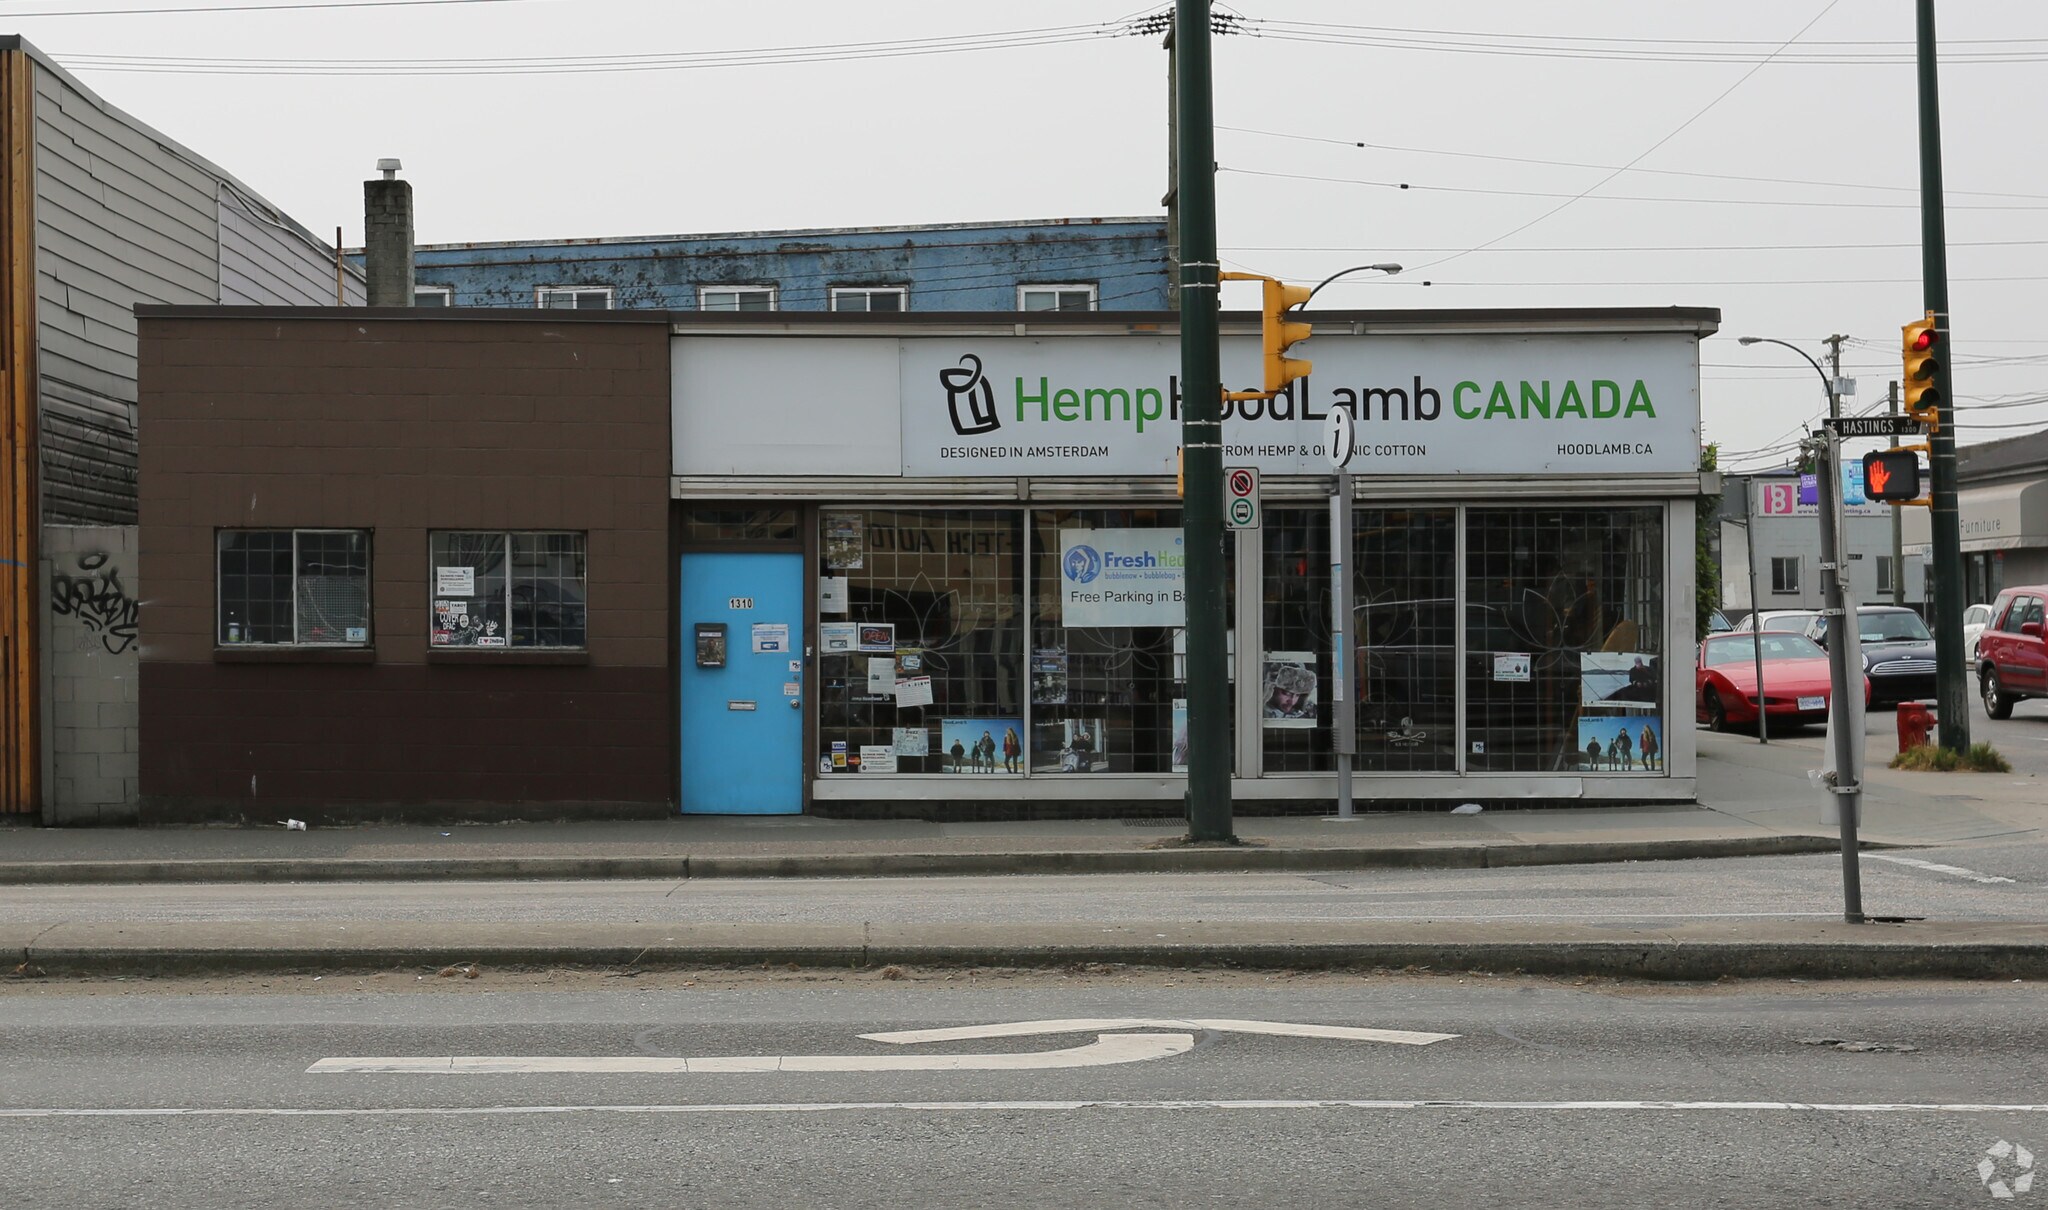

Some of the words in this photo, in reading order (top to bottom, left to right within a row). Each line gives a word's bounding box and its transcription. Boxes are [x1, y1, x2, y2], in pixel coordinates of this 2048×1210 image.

[1453, 379, 1656, 420] CANADA
[1843, 420, 1894, 434] HASTINGS
[940, 446, 1006, 458] DESIGNED
[1010, 446, 1023, 457] IN
[1027, 445, 1109, 458] AMSTERDAM
[1258, 445, 1295, 456] HEMP
[1299, 445, 1309, 456] &
[1375, 444, 1426, 456] COTTON
[1557, 443, 1653, 455] HOODLAMB.CA
[1960, 517, 2001, 534] Furniture
[730, 598, 753, 609] 1310
[1071, 591, 1100, 603] Free
[1104, 590, 1153, 604] Parking
[1158, 590, 1169, 602] in
[864, 630, 889, 641] OPEN
